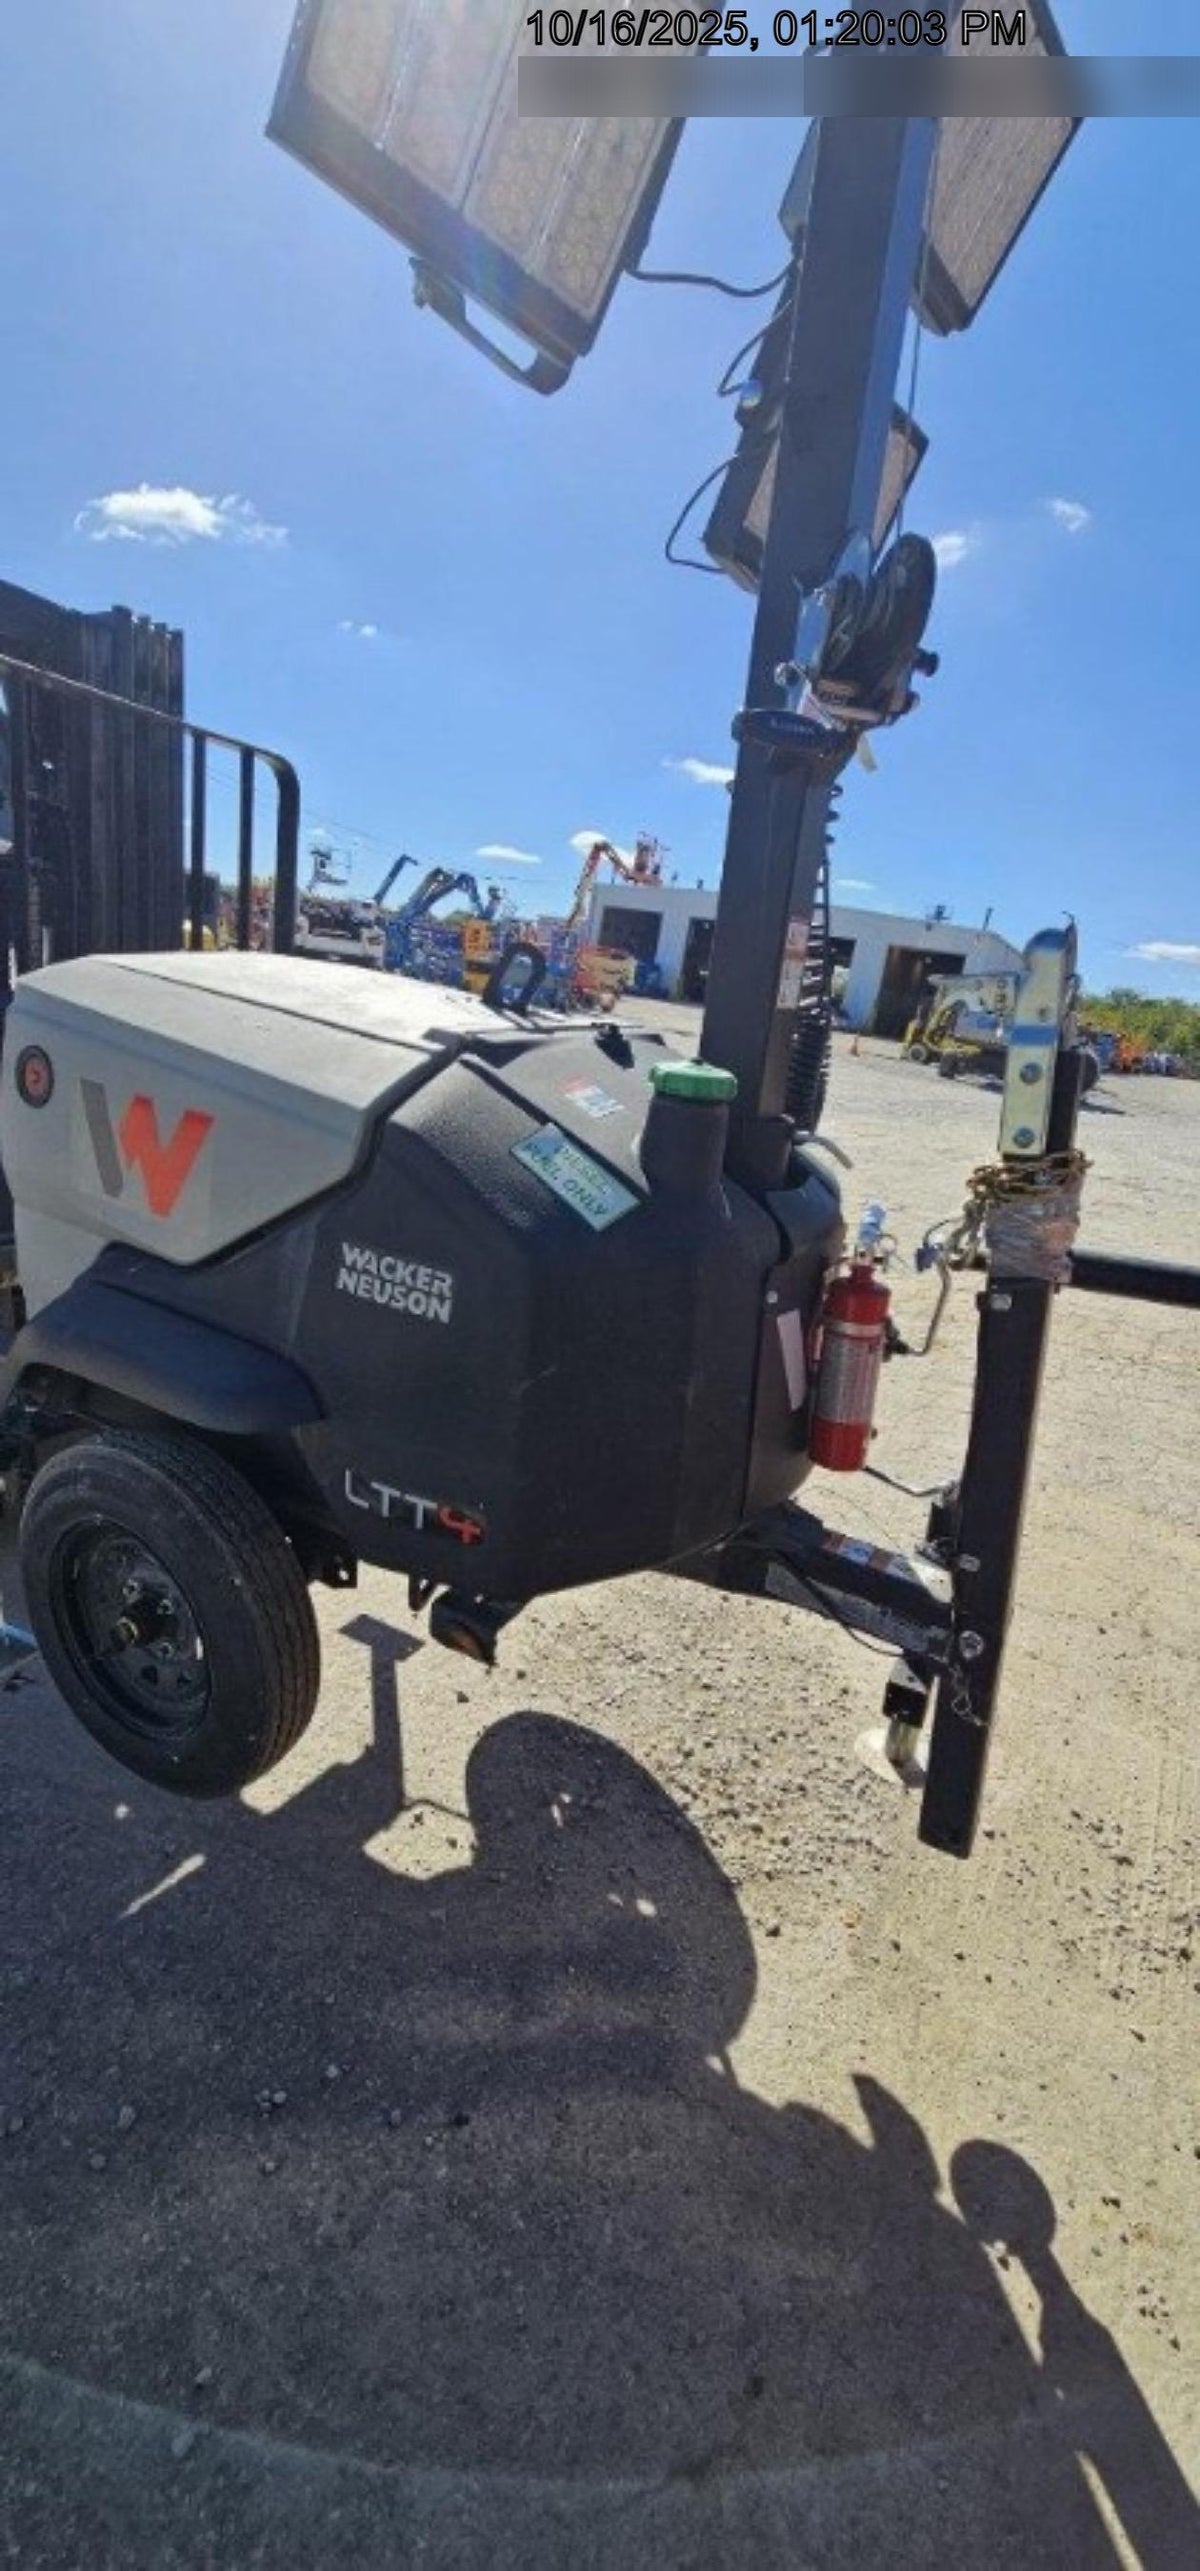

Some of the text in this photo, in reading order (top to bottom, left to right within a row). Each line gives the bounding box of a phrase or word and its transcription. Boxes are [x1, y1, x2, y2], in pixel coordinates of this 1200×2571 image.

[562, 1178, 609, 1216] ONLY
[336, 1267, 452, 1323] NEUSON
[342, 1242, 453, 1298] WACKER
[344, 1469, 484, 1545] LTT4
